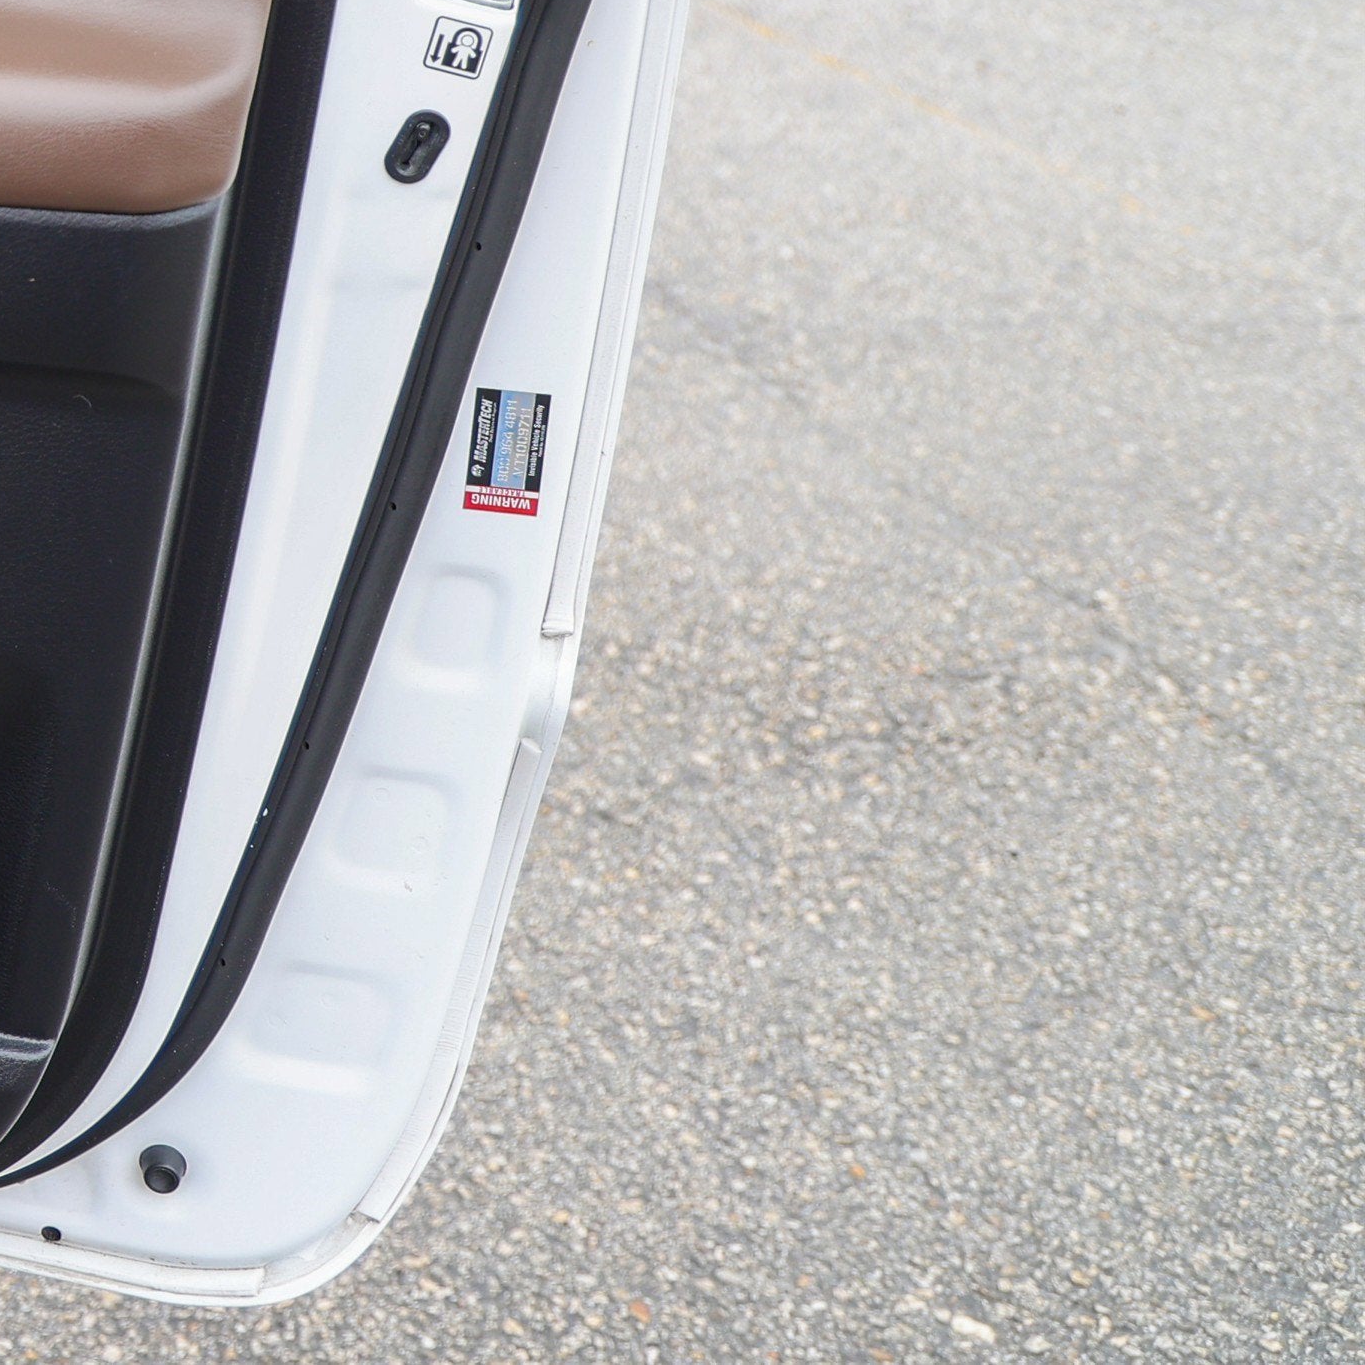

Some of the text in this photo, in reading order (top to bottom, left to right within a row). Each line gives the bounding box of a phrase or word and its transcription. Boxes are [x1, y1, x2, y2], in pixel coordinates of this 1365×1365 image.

[534, 404, 546, 428] Security
[531, 428, 540, 451] Vehicle
[471, 493, 531, 510] WARNING
